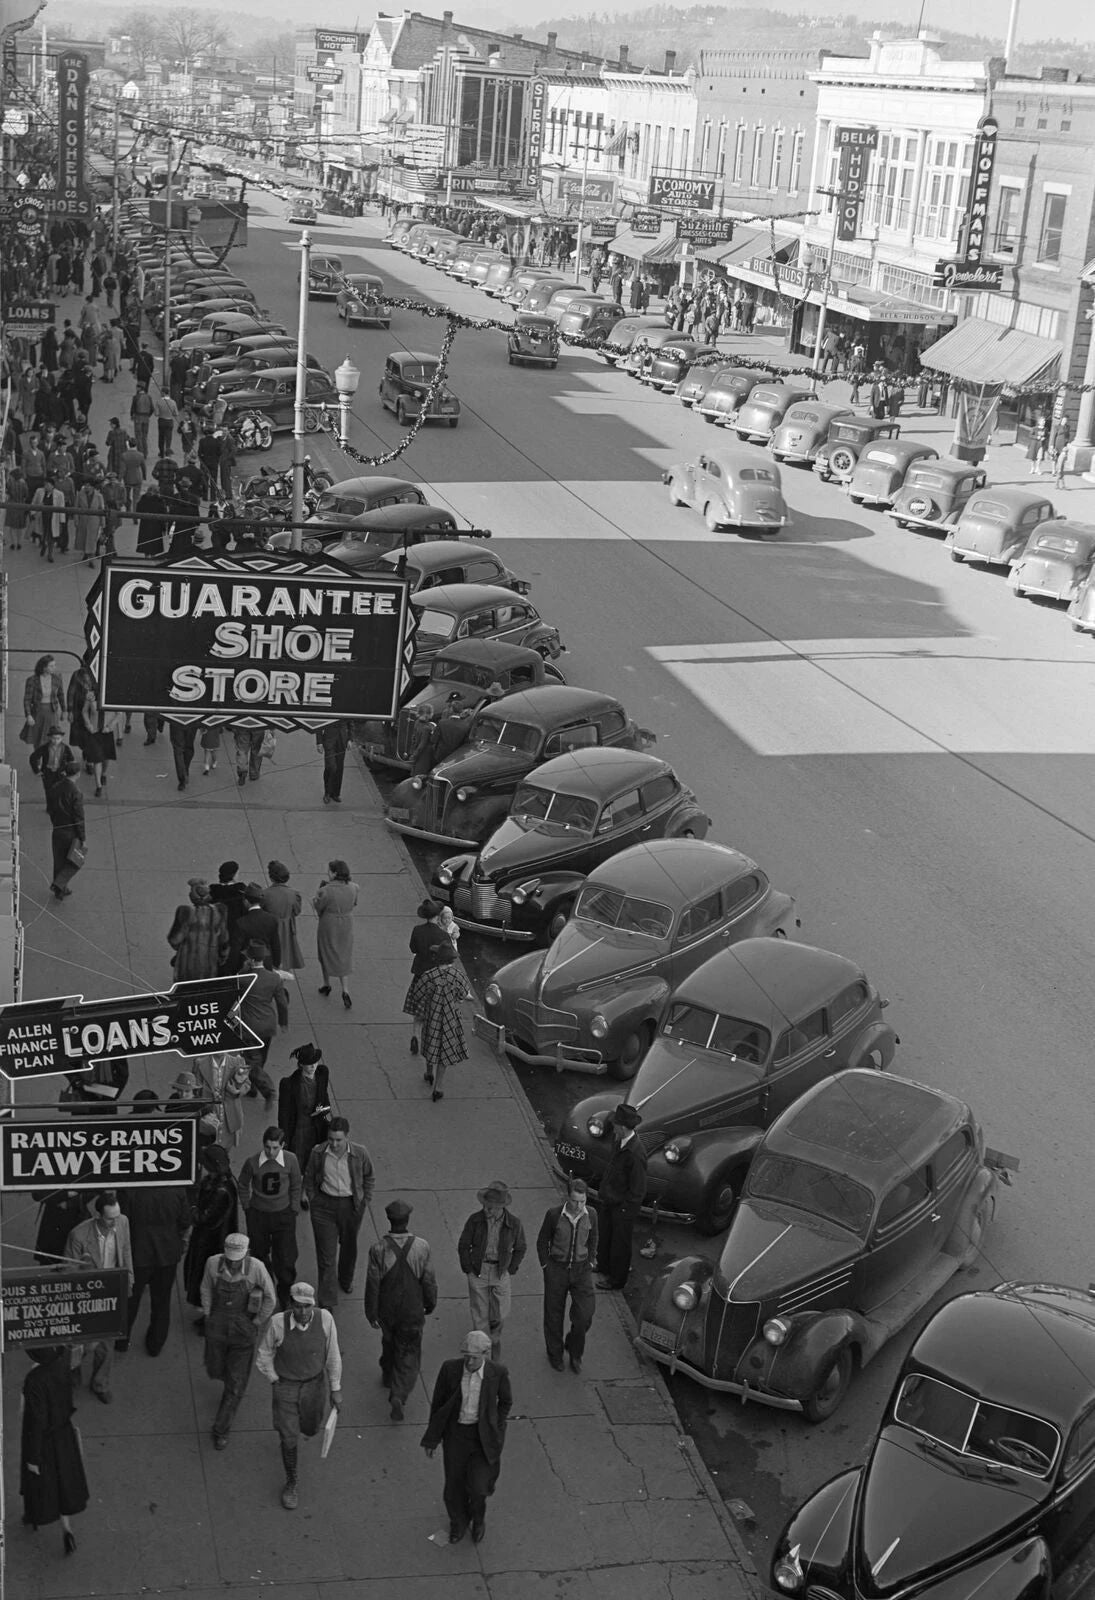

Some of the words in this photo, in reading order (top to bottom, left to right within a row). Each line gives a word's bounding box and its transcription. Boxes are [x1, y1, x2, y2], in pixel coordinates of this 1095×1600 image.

[64, 59, 82, 68] THE
[66, 69, 78, 111] DAN
[841, 131, 876, 145] BELK
[66, 120, 78, 189] COHEN
[570, 182, 602, 197] CocaCola
[653, 177, 714, 200] ECONOMY
[668, 191, 693, 199] AUTO
[845, 154, 861, 231] HUDSON
[44, 199, 88, 213] HOES
[660, 198, 700, 207] STORES
[967, 142, 994, 261] HOFFMANS
[943, 263, 998, 288] Jewelers
[9, 307, 49, 319] LOANS
[118, 578, 397, 619] GUARANTEE
[209, 622, 354, 662] SHOE
[168, 665, 334, 707] STORE
[188, 1002, 219, 1016] USE
[7, 1023, 53, 1040] ALLEN
[177, 1018, 217, 1033] STAIR
[62, 1015, 171, 1058] LOANS
[191, 1032, 222, 1046] WAY
[0, 1038, 58, 1056] FINANCE
[14, 1054, 54, 1070] PLAN
[11, 1130, 87, 1148] RAINS
[92, 1132, 109, 1146] &
[111, 1128, 183, 1146] RAINS
[12, 1148, 182, 1177] LAWYERS
[261, 1172, 281, 1195] G
[0, 1286, 26, 1298] OUIS
[41, 1282, 72, 1294] KLEIN
[87, 1279, 105, 1290] CO.
[4, 1295, 48, 1305] CCOUNTANTS
[54, 1291, 92, 1301] AUDITORS
[3, 1306, 20, 1320] ME
[77, 1297, 118, 1315] SECURITY
[8, 1328, 46, 1340] NOTARY
[50, 1323, 82, 1336] PUBLIC
[24, 1317, 70, 1328] SYSTEMS
